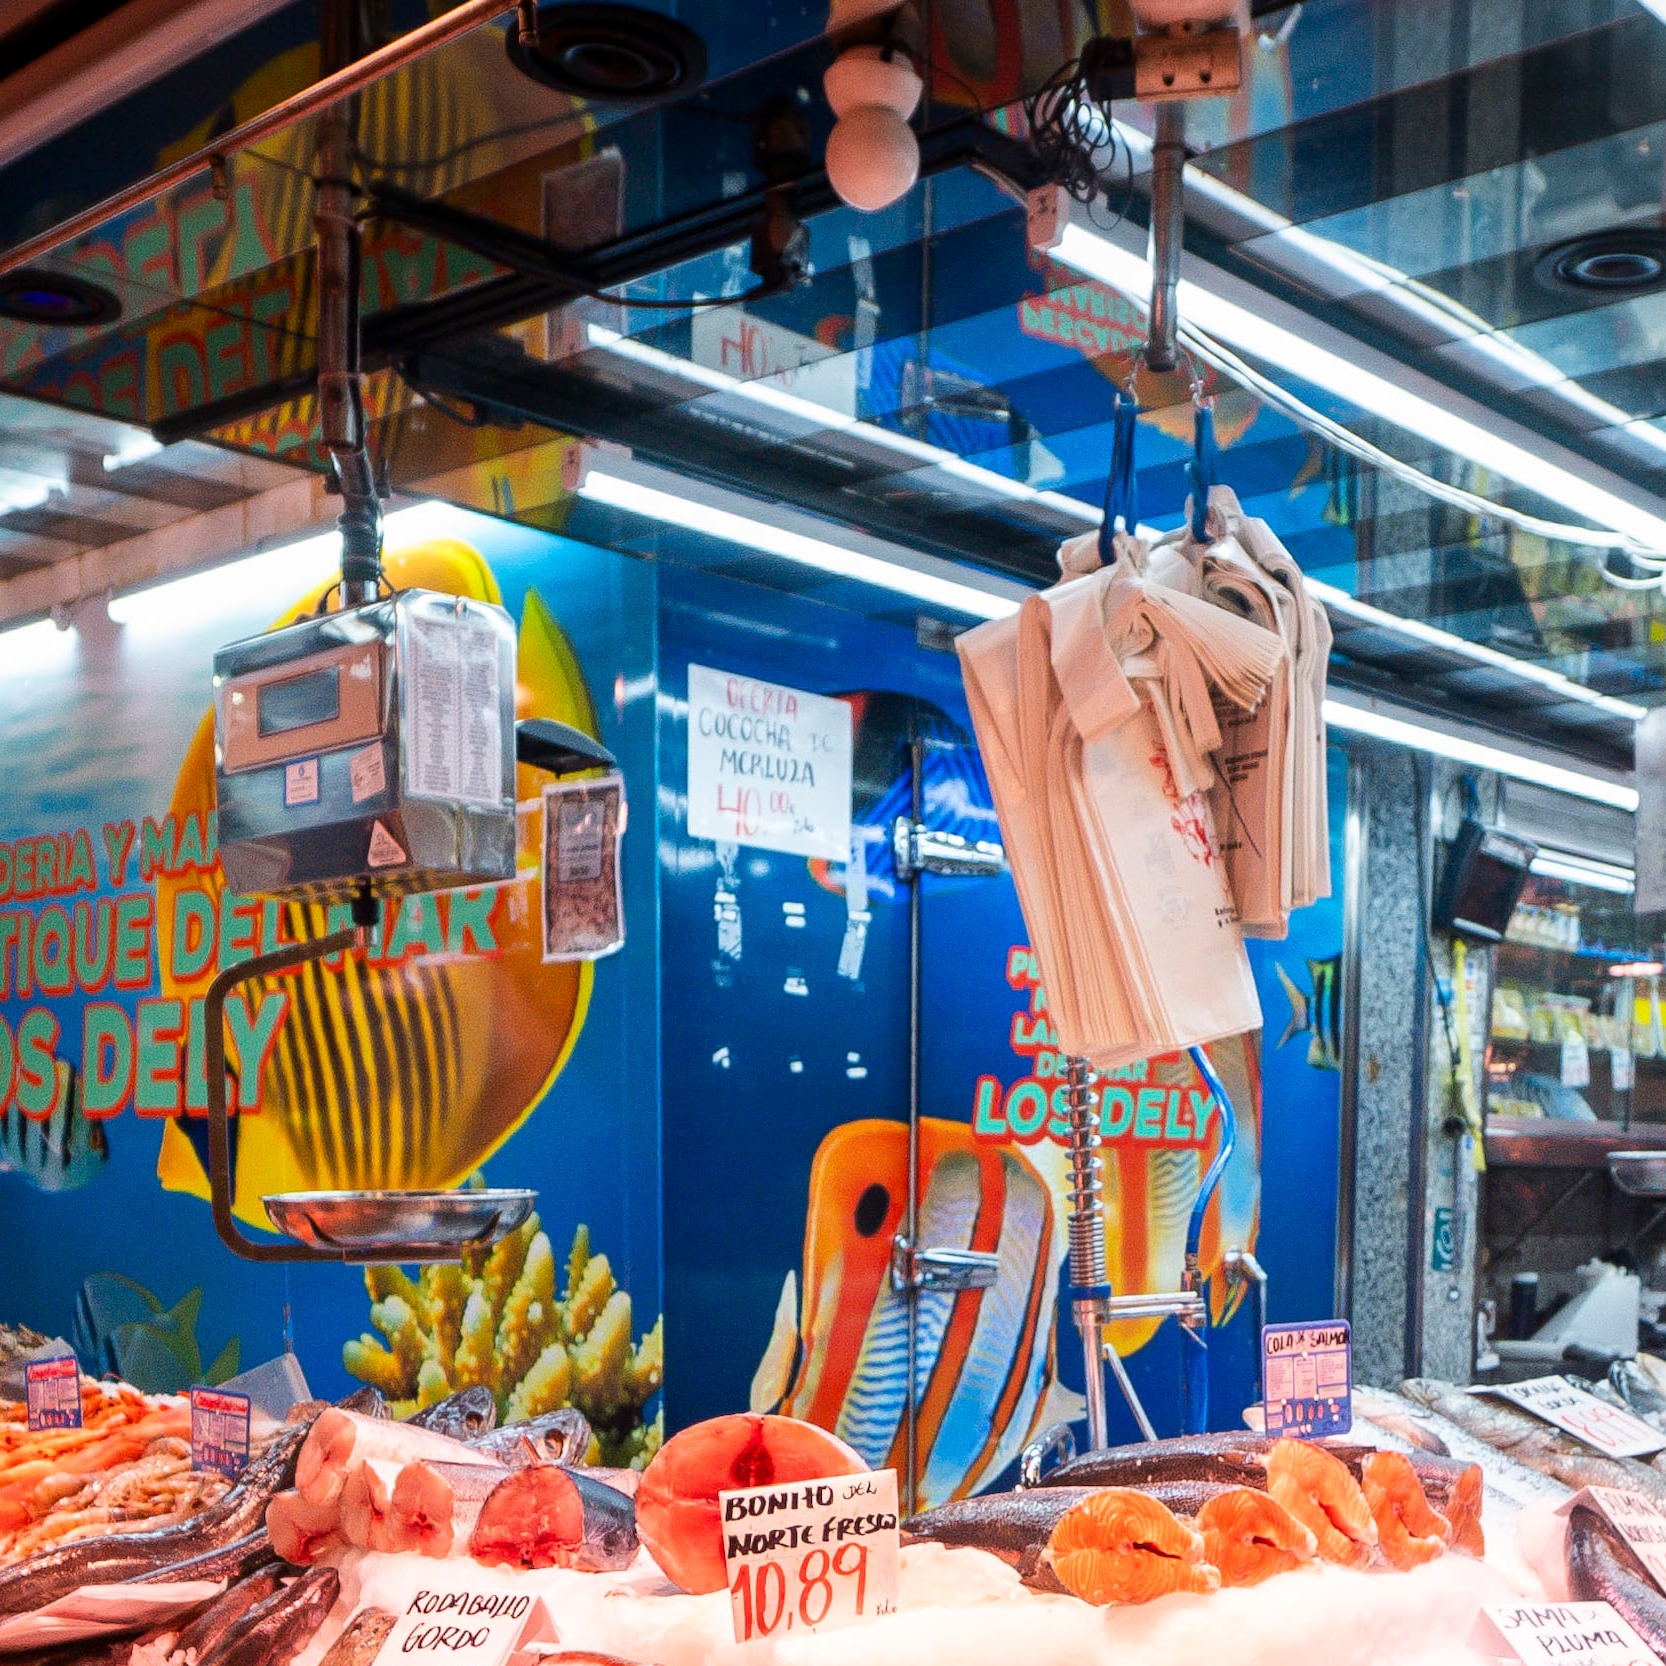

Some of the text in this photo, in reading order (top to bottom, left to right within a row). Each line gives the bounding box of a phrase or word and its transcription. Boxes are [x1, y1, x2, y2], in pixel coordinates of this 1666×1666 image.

[103, 817, 134, 887] Y
[80, 989, 290, 1120] DELY
[1096, 1084, 1219, 1141] DELY
[724, 1484, 834, 1522] BONITO
[727, 1513, 897, 1559] NORTE FRESCO
[406, 1590, 530, 1619] RODABALLO
[401, 1622, 491, 1653] GORDO
[1535, 1628, 1630, 1657] PLUMA
